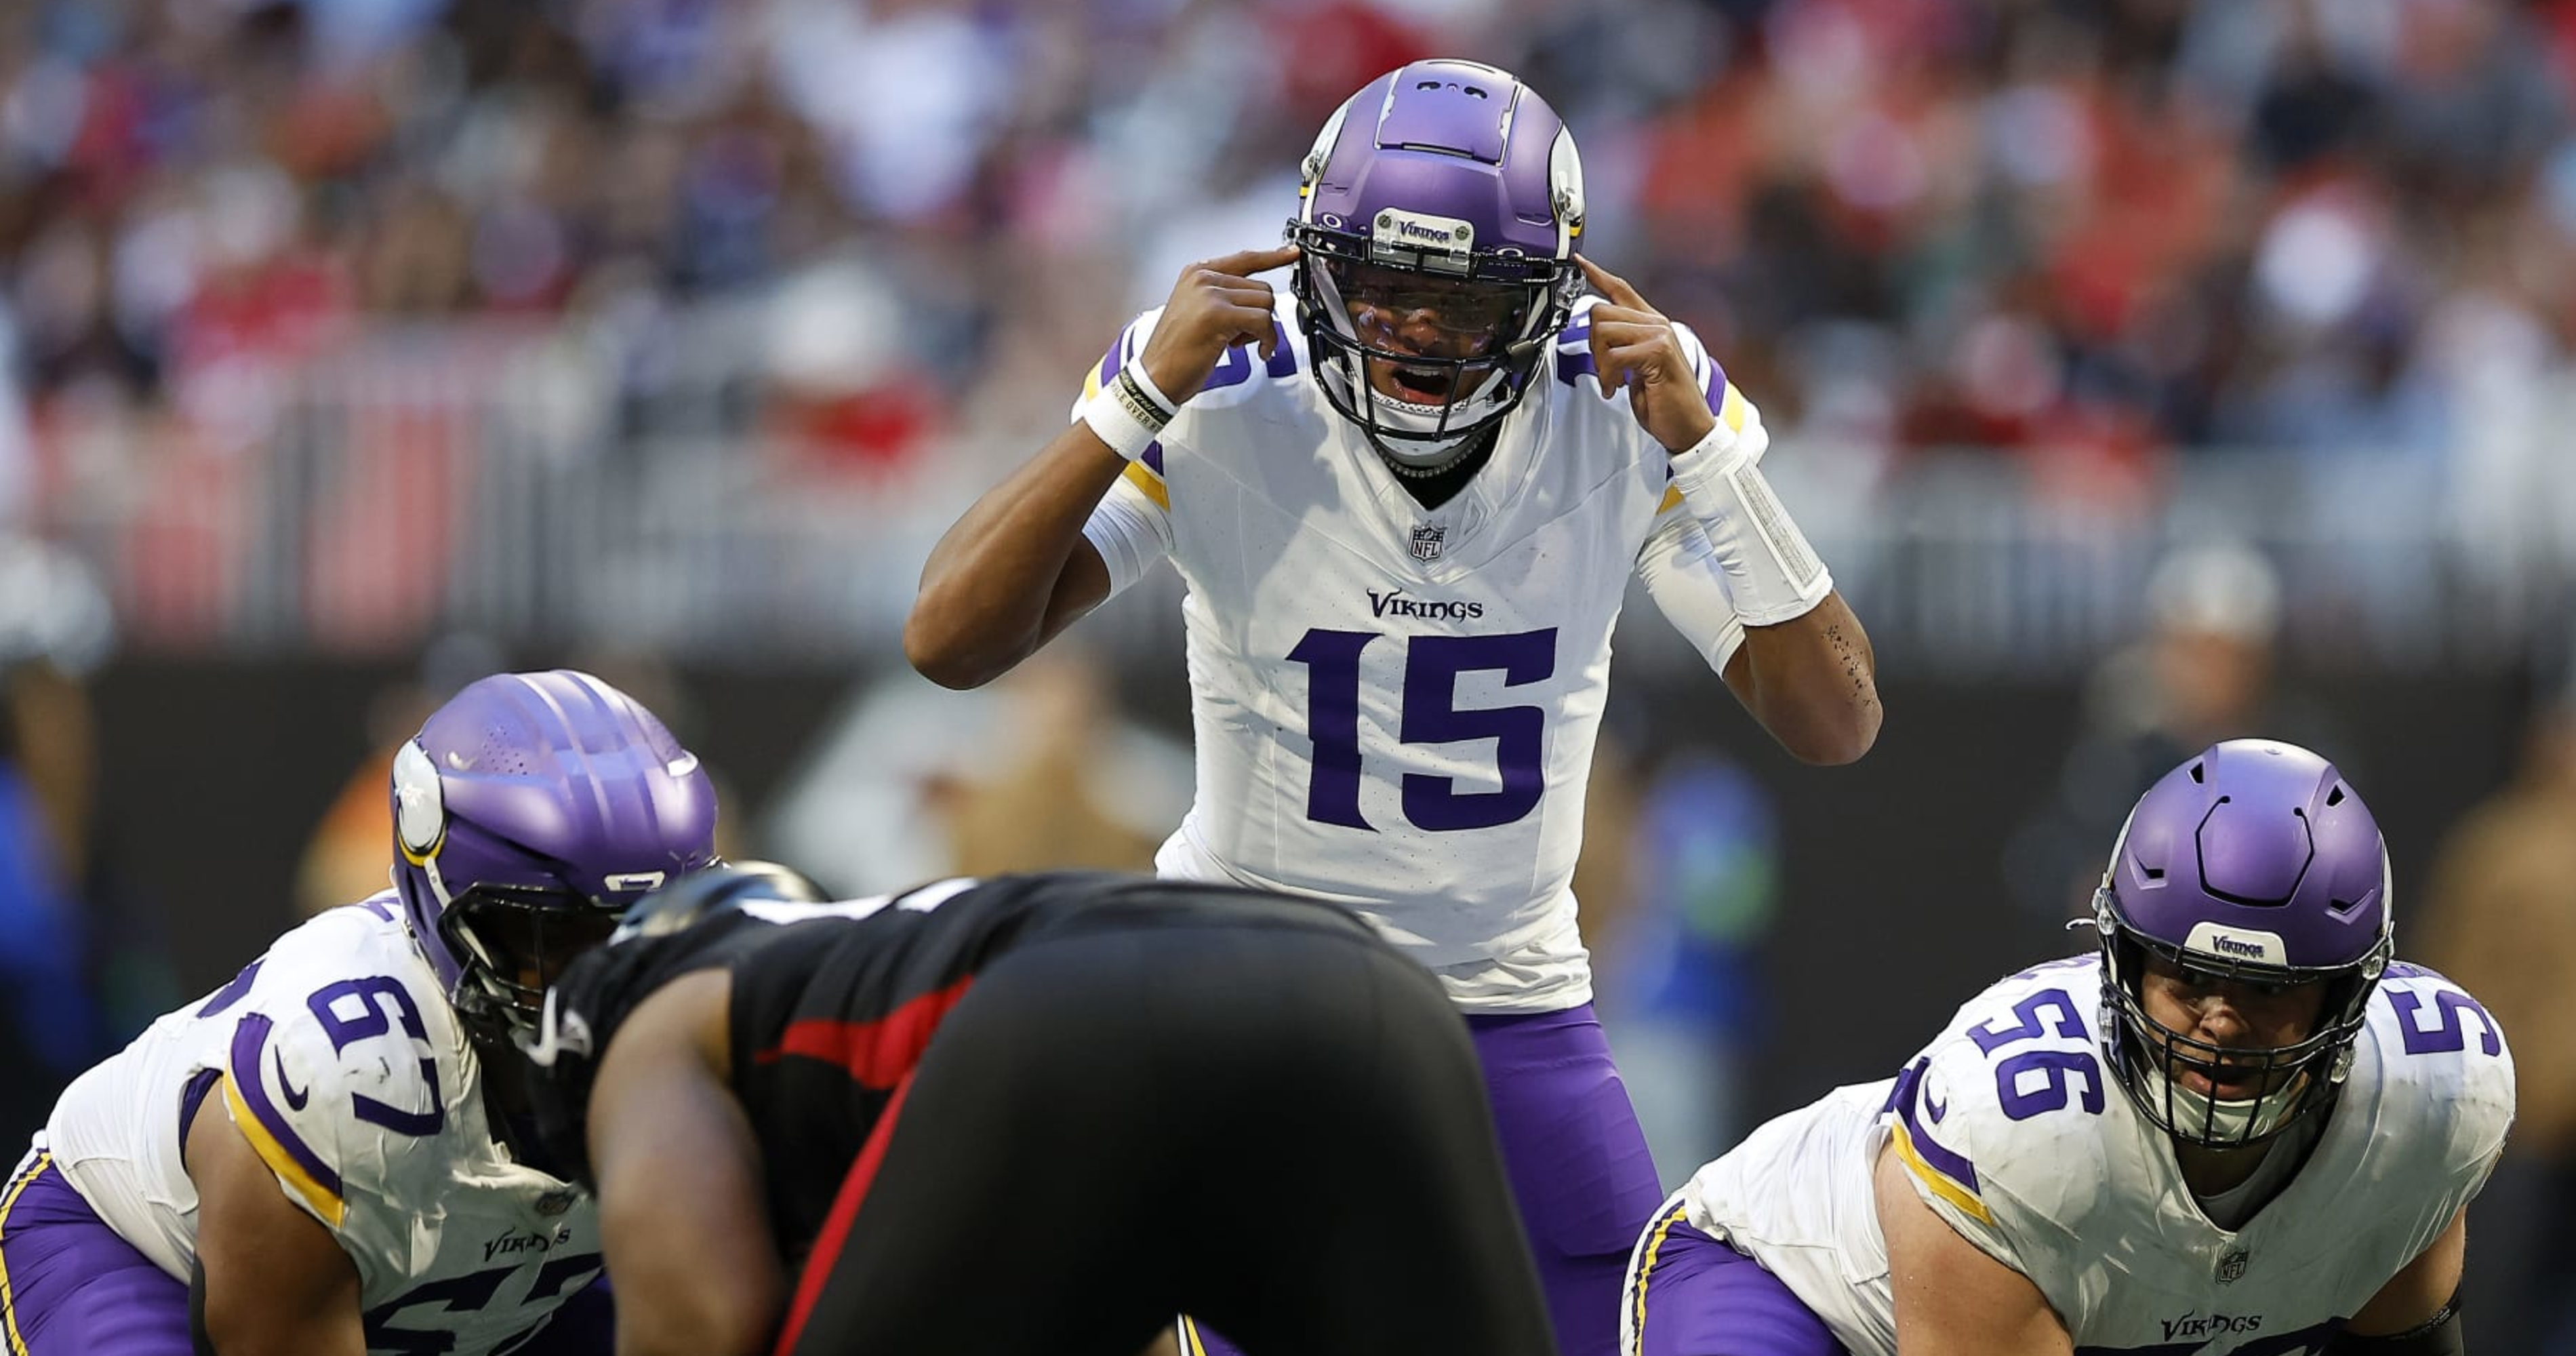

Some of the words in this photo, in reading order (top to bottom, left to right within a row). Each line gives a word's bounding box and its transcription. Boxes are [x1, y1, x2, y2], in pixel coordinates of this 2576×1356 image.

[1126, 401, 1151, 424] OVER
[1413, 541, 1438, 557] NFL
[1285, 627, 1558, 833] 15
[307, 975, 445, 1136] 67
[1966, 988, 2105, 1121] 56
[2381, 962, 2501, 1057] 5
[2221, 1261, 2244, 1279] NFL
